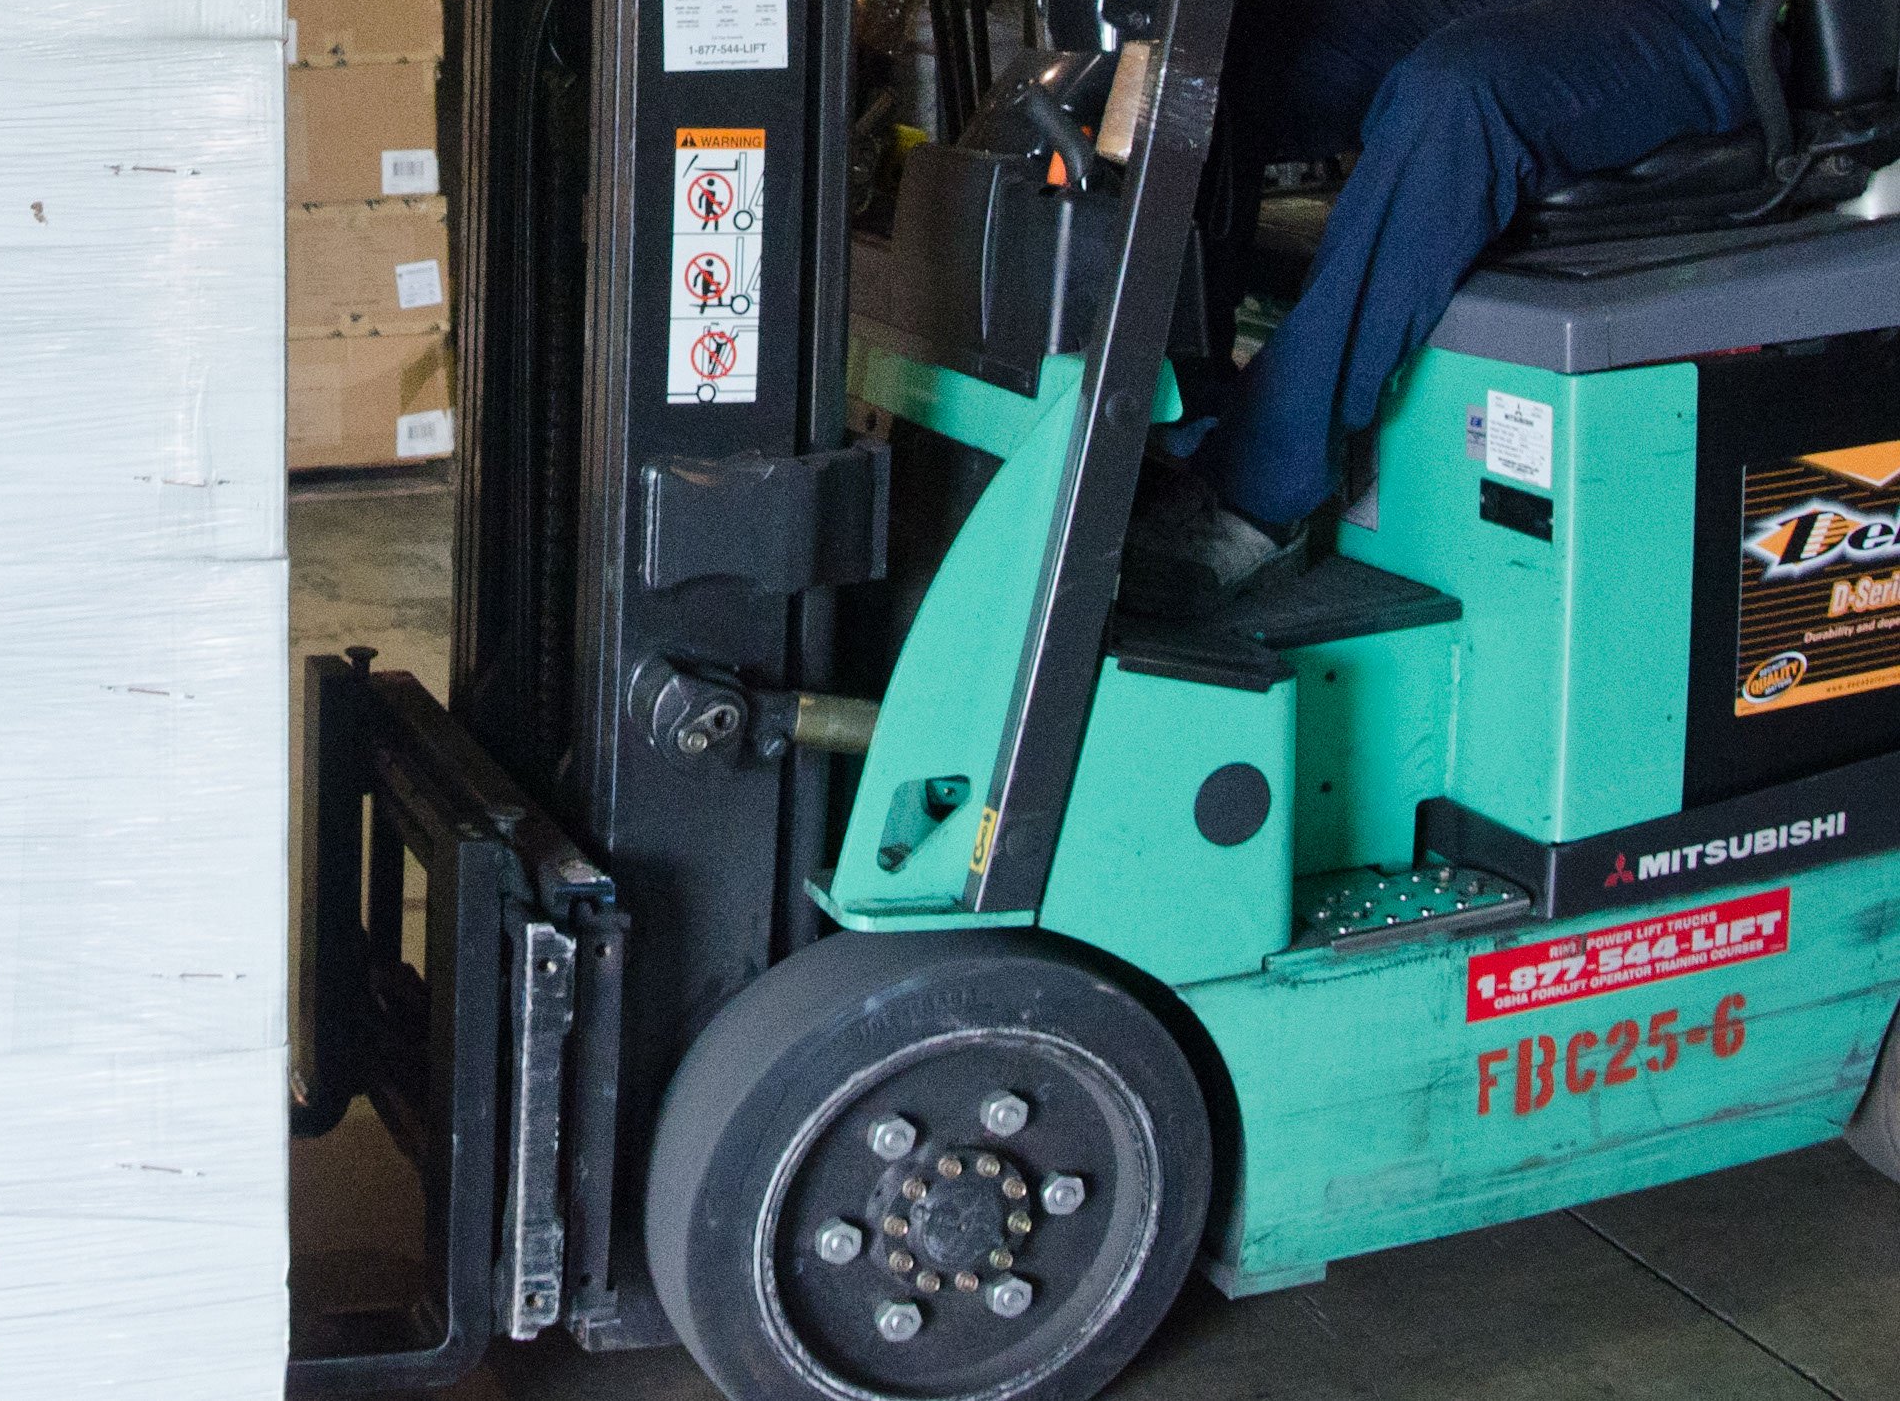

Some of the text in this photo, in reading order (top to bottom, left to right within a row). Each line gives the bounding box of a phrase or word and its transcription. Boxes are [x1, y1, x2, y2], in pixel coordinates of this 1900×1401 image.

[689, 43, 767, 55] 1-877-544-LIFT
[700, 135, 761, 149] WARNING
[1832, 572, 1900, 615] D-Seri
[1856, 620, 1876, 635] and
[1752, 661, 1799, 695] QUALITY
[1638, 812, 1847, 881] MITSUBISHI
[1586, 927, 1633, 951] POWER
[1636, 920, 1663, 939] LIFT
[1667, 910, 1718, 933] TRUCKS
[1477, 911, 1782, 999] 1-877-544-LIFT
[1494, 995, 1529, 1010] OSHA
[1531, 980, 1588, 1001] FORKLIFT
[1589, 966, 1652, 989] OPERATOR
[1655, 953, 1708, 975] TRAINING
[1710, 940, 1764, 962] COURSES
[1477, 993, 1746, 1115] FBC25-6
